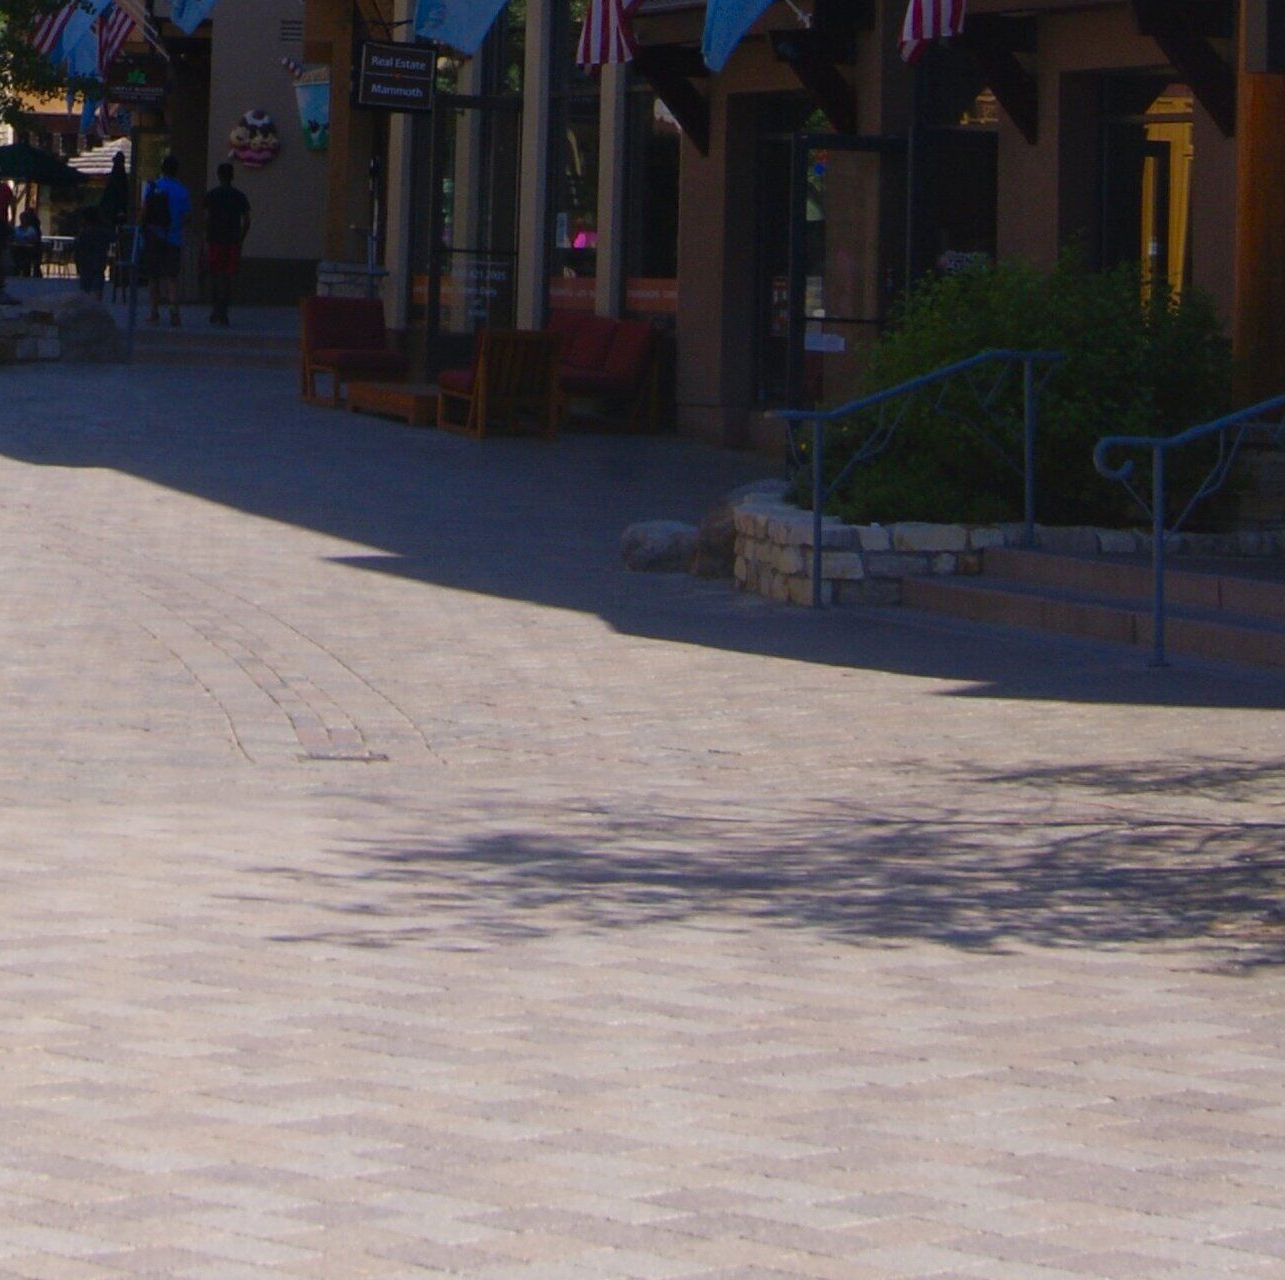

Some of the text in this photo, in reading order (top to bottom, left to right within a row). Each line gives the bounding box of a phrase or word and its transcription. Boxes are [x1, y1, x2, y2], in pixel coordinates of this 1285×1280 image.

[371, 56, 426, 71] Real Estate
[371, 84, 423, 97] Mammoth
